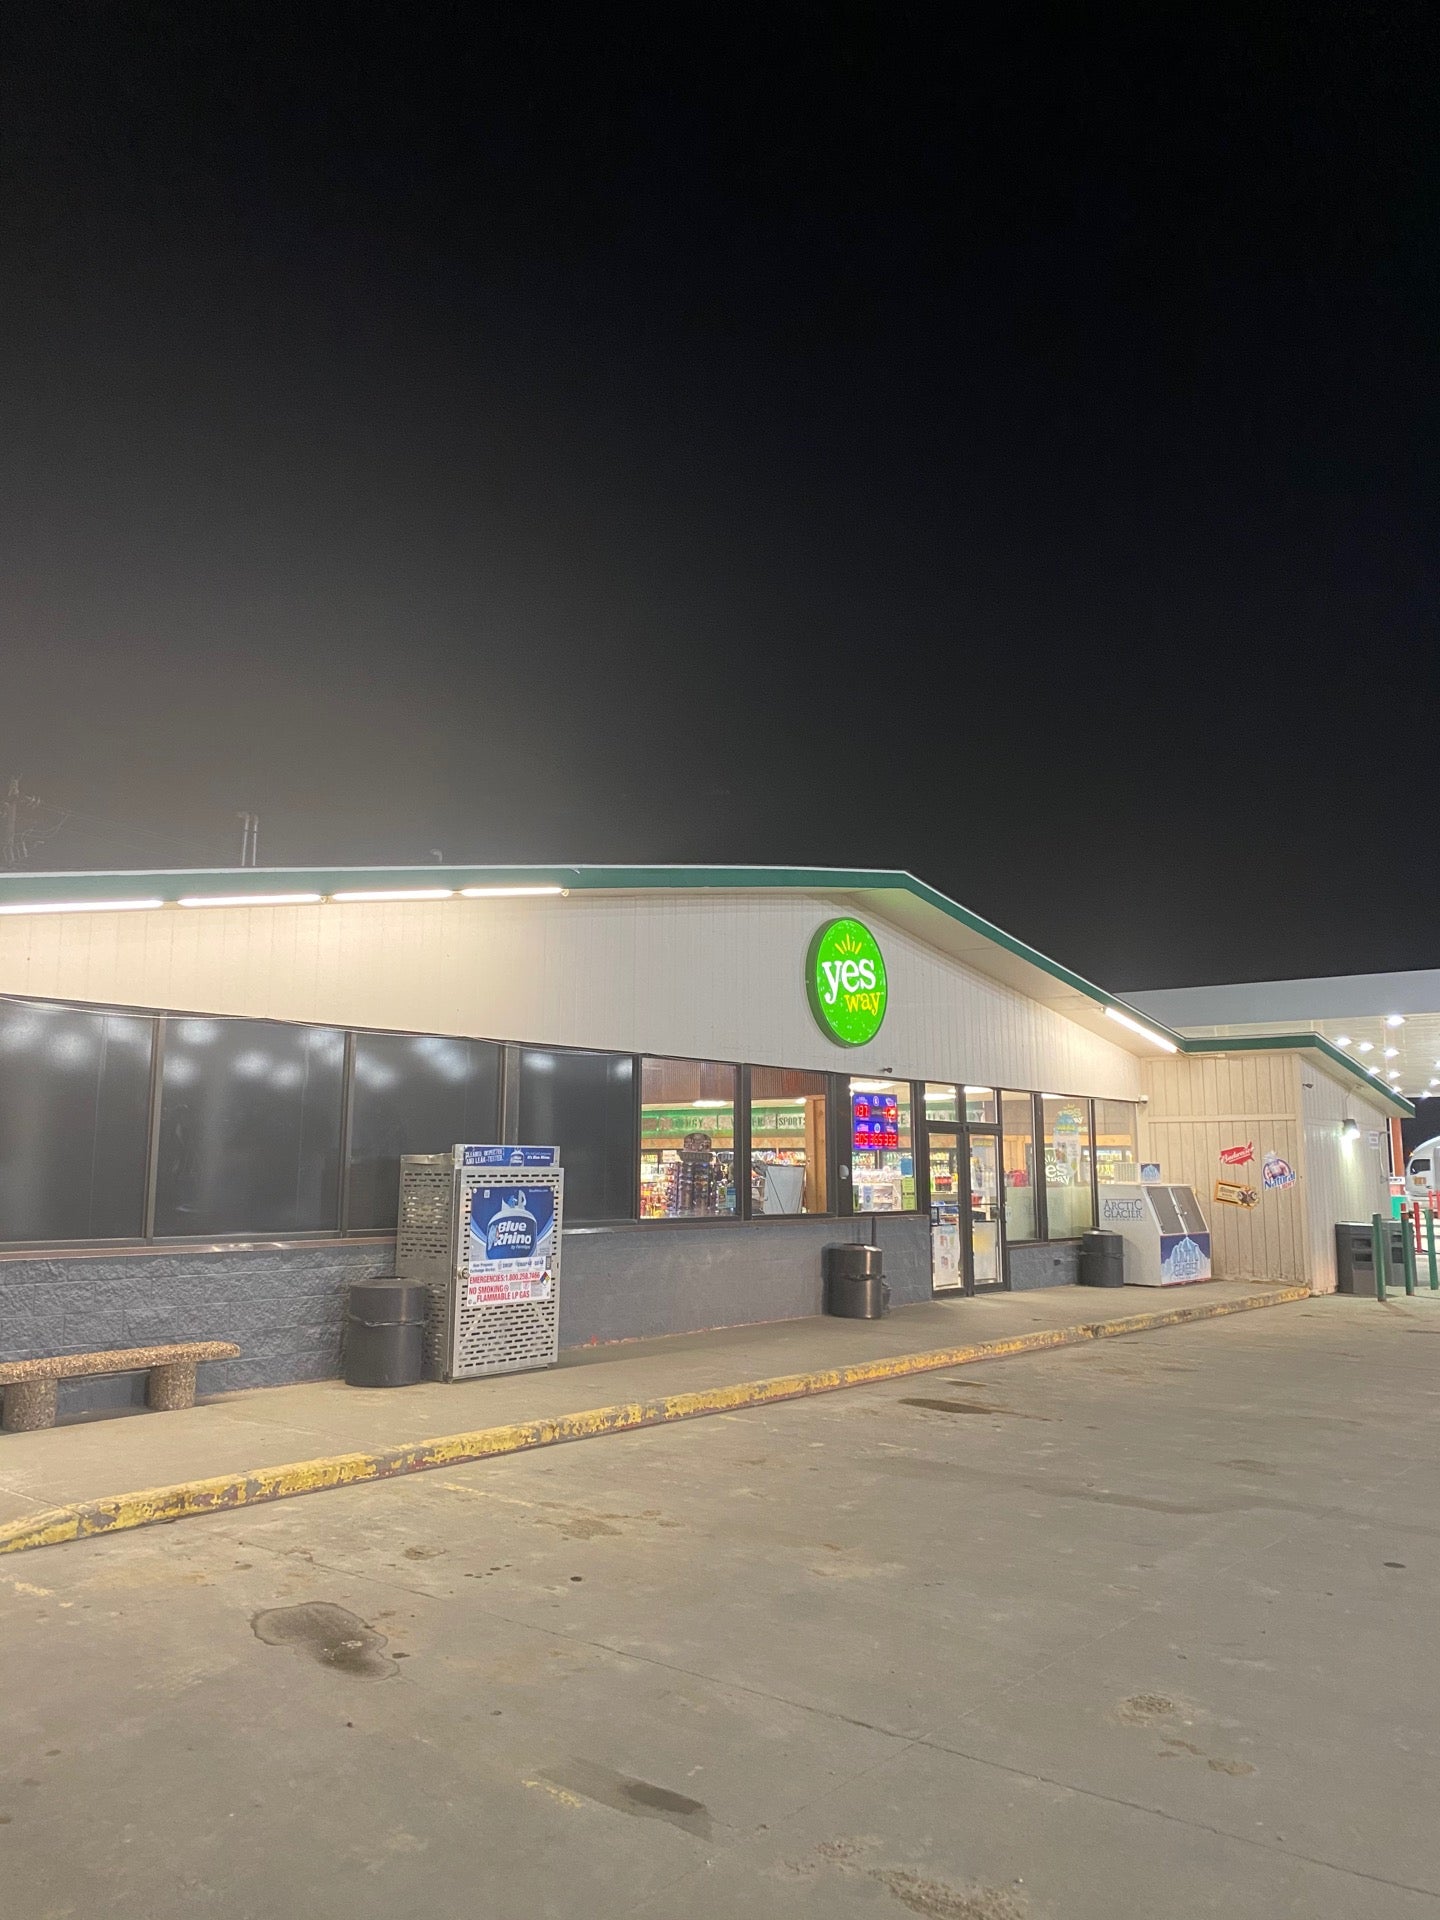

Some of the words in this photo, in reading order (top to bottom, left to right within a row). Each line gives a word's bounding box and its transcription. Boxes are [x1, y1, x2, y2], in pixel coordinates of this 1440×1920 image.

[821, 958, 877, 1005] yes
[844, 992, 881, 1017] way
[1264, 1170, 1296, 1190] Natural
[1103, 1199, 1143, 1211] ARCTIC
[1103, 1210, 1143, 1219] GLACIER
[498, 1220, 527, 1233] Blue
[494, 1232, 532, 1246] Rhino
[469, 1287, 477, 1295] NO
[478, 1284, 504, 1295] SMOKING
[476, 1292, 511, 1303] FLAMMABLE
[512, 1291, 519, 1300] LP
[519, 1290, 530, 1299] GAS
